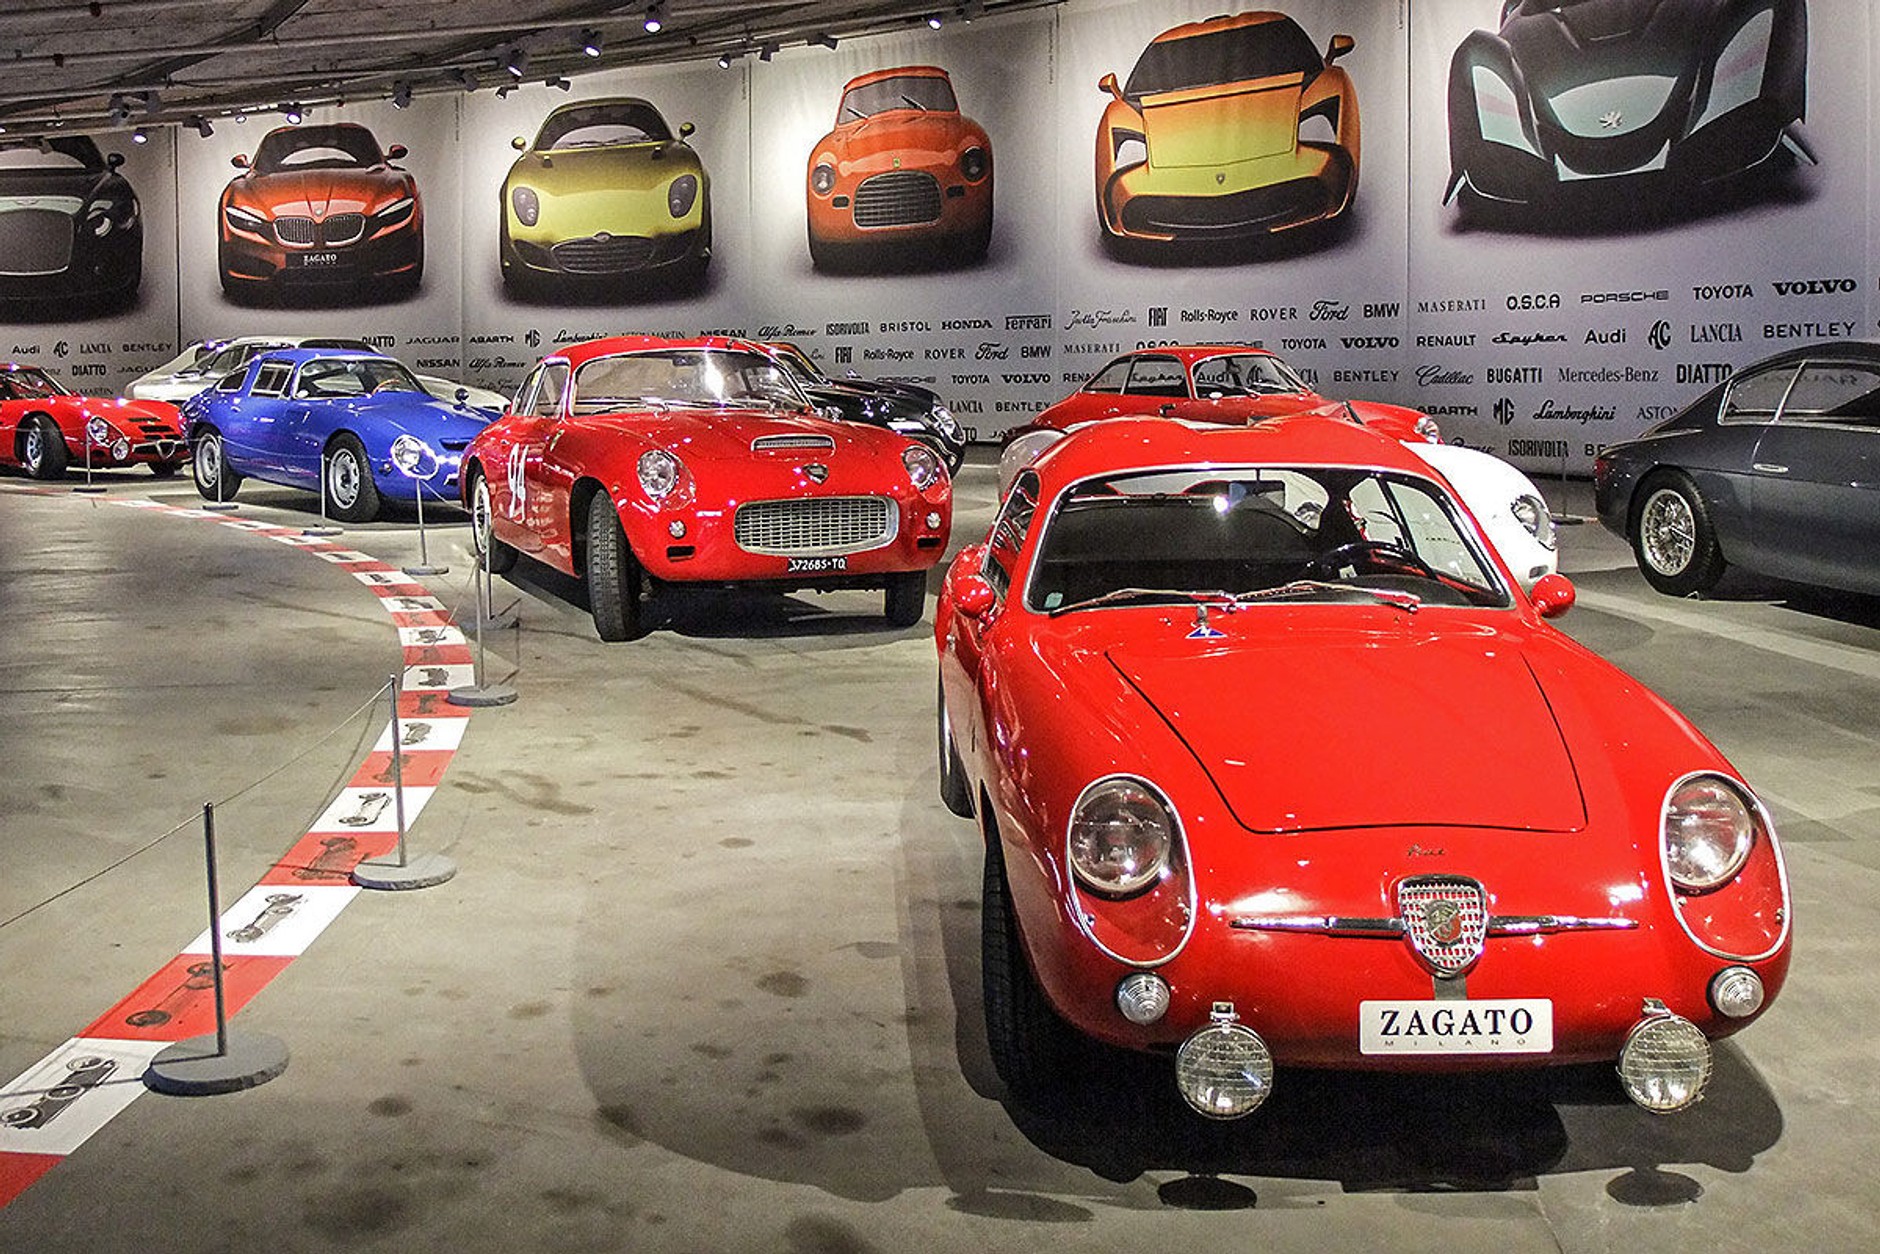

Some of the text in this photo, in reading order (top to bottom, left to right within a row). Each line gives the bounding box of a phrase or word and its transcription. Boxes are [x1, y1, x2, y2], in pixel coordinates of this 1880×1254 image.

[1417, 299, 1486, 312] MASERATI
[1581, 290, 1669, 303] PORSCHE
[1693, 285, 1754, 300] TOYOTA
[1772, 279, 1857, 296] VOLVO
[1149, 308, 1168, 327] FIAT
[1250, 307, 1298, 321] ROVER
[1309, 300, 1349, 321] Ford
[1363, 303, 1400, 318] BMW
[879, 321, 932, 332] BRISTOL
[941, 319, 993, 330] HONDA
[1005, 314, 1052, 330] Ferrari
[406, 335, 460, 345] JAGUAR
[469, 335, 514, 344] ABARTH
[525, 330, 540, 348] MG
[1417, 334, 1476, 347] RENAULT
[1584, 329, 1626, 344] Audi
[1648, 320, 1671, 350] AC
[1691, 324, 1743, 342] LANCIA
[1763, 322, 1856, 338] BENTLEY
[12, 341, 173, 358] Audi AC LANCIA BENTLEY
[835, 347, 852, 363] FIAT
[925, 348, 966, 360] ROVER
[974, 342, 1009, 361] Ford
[1021, 346, 1052, 358] BMW
[1064, 337, 1399, 354] MASERATI TOYOTA VOLVO
[72, 364, 107, 376] DIATTO
[417, 358, 460, 368] NISSAN
[951, 374, 990, 384] TOYOTA
[1001, 374, 1051, 384] VOLVO
[1333, 370, 1399, 382] BENTLEY
[1415, 364, 1733, 388] Cadillac BUGATTI Mercedes-Benz DIATTO
[950, 400, 1051, 413] LANCIA BENTLEY
[1417, 398, 1678, 425] ABARTH MG Lamborghini ASTO
[1508, 439, 1569, 457] ISORIVOLTA
[1380, 1008, 1533, 1036] ZAGATO
[1384, 1039, 1526, 1047] MILANO
